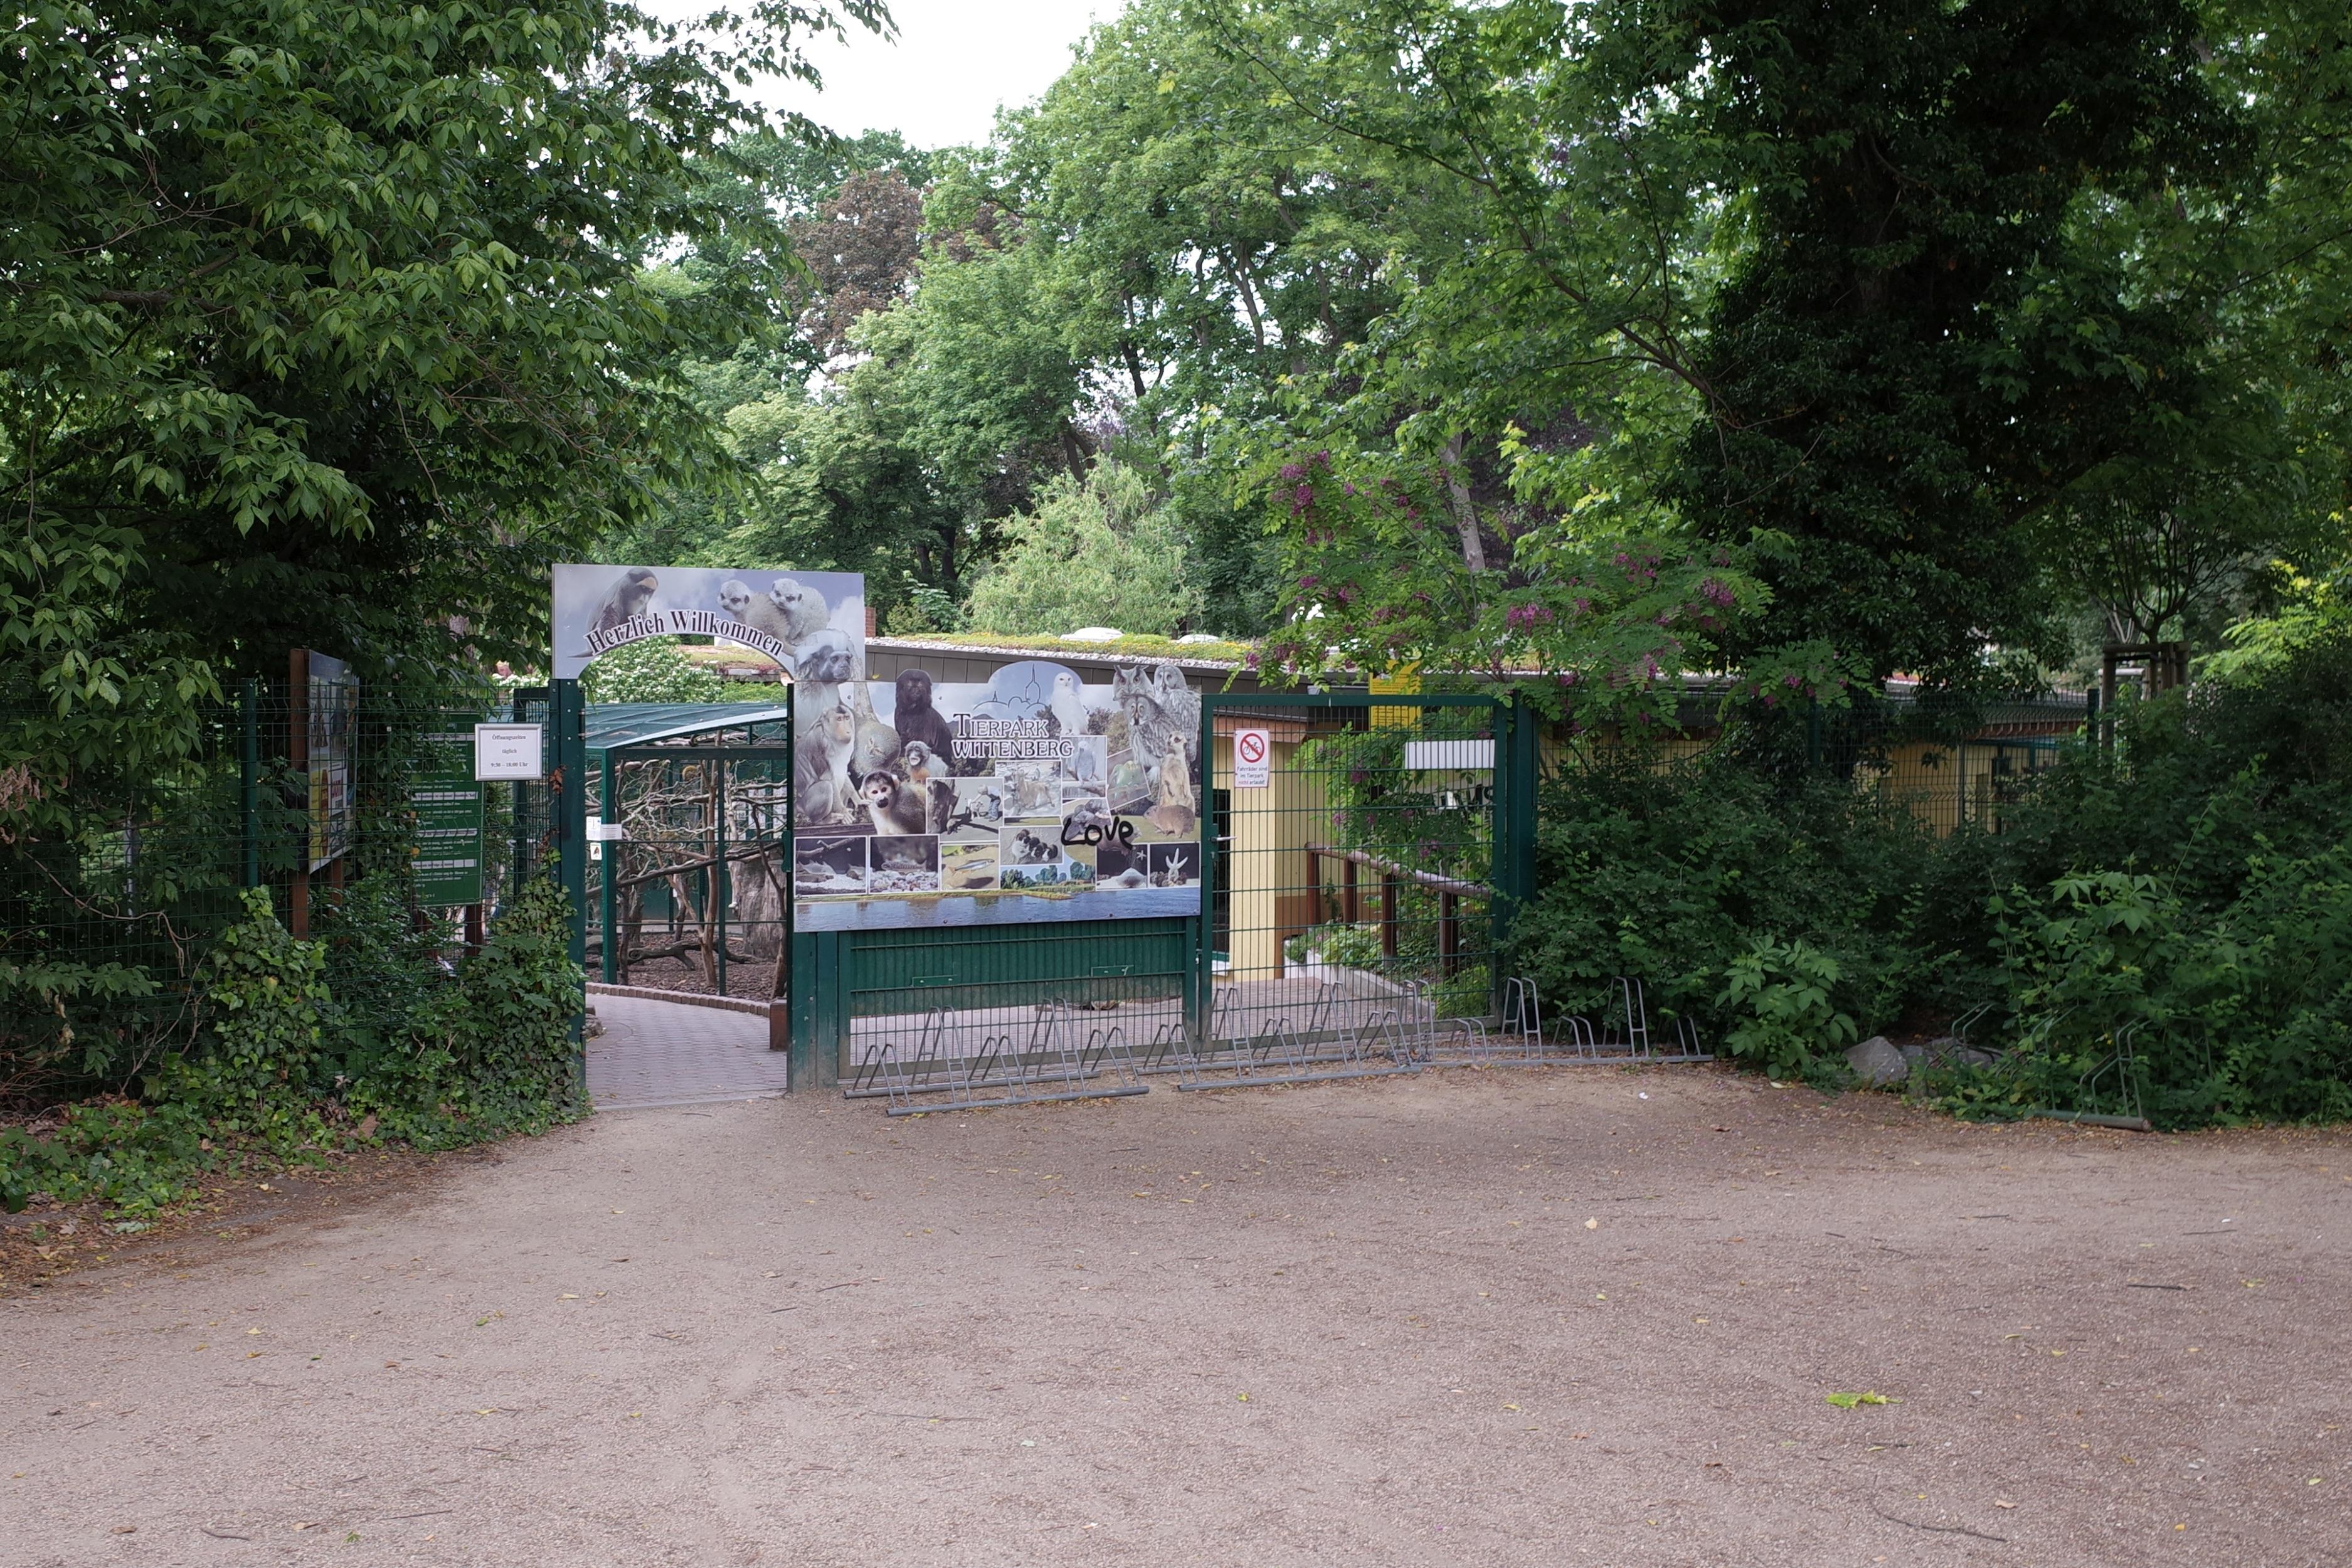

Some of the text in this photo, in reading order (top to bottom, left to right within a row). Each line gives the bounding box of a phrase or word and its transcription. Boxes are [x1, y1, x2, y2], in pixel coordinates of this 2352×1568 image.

[585, 611, 783, 657] Herzlich Willkommen
[952, 712, 1049, 737] TIERPARK
[952, 740, 1073, 757] WITTENBERG
